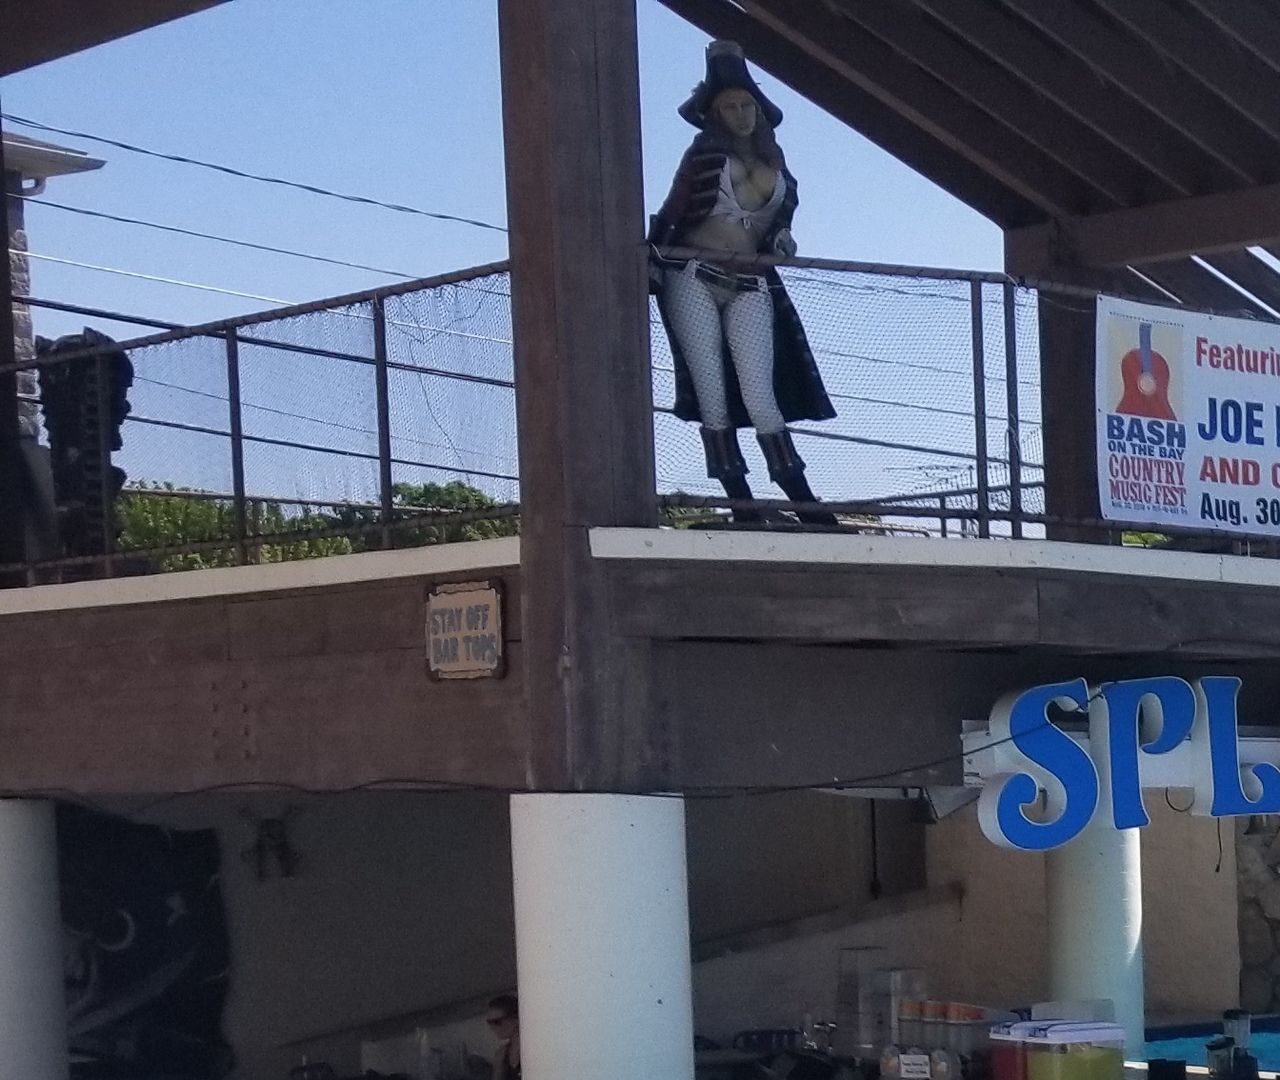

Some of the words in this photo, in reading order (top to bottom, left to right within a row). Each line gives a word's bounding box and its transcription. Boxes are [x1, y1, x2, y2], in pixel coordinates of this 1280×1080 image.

[1106, 413, 1187, 449] BASH
[1197, 397, 1264, 446] JOE
[1107, 439, 1127, 454] ON
[1129, 441, 1155, 457] THE
[1158, 446, 1185, 461] BAY
[1108, 452, 1186, 486] COUNTRY
[1199, 455, 1262, 487] AND
[1108, 478, 1153, 504] MUSIC
[1153, 484, 1187, 508] FEST
[1200, 492, 1249, 527] Aug.
[431, 606, 463, 636] STAY
[432, 636, 460, 665] BAR
[463, 632, 498, 665] TOPS
